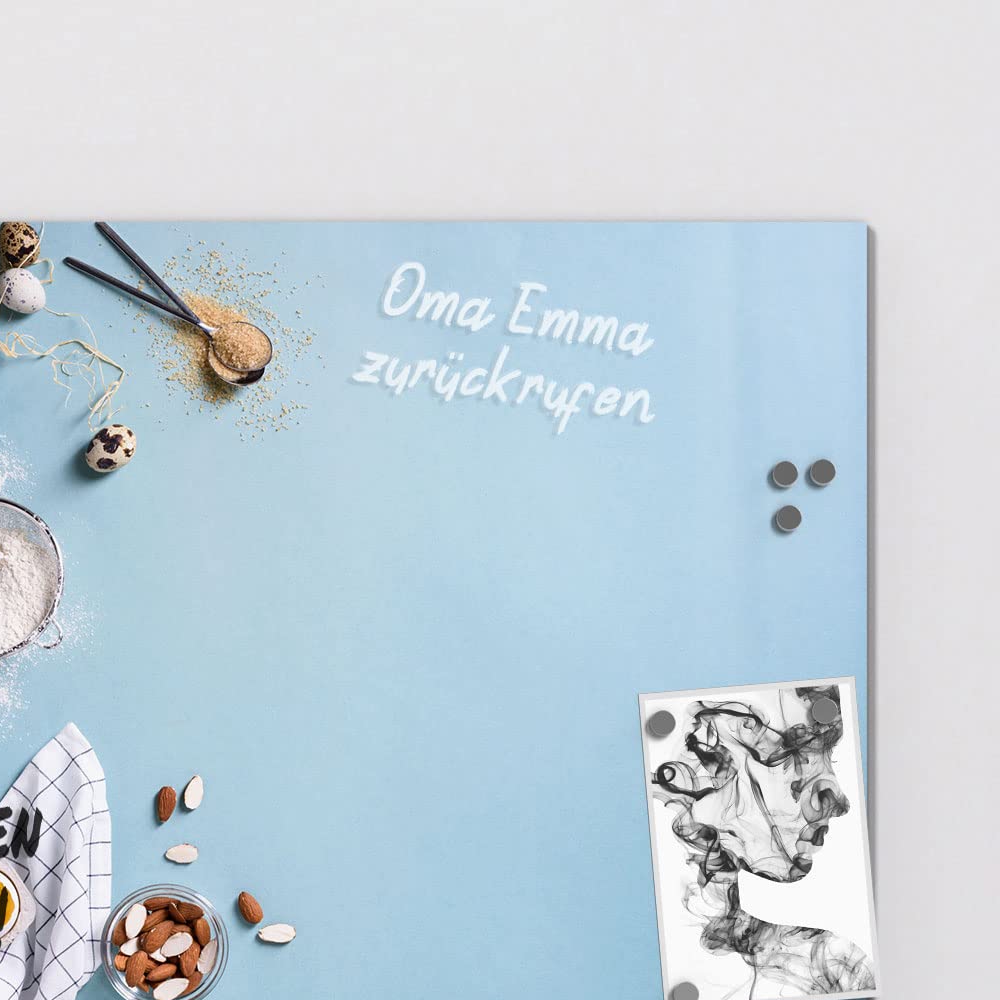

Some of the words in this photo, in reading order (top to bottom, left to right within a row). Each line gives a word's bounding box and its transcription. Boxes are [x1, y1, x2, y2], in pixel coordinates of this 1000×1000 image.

[383, 261, 495, 332] Oma
[508, 282, 655, 356] Emma
[351, 345, 656, 435] zurückrufen
